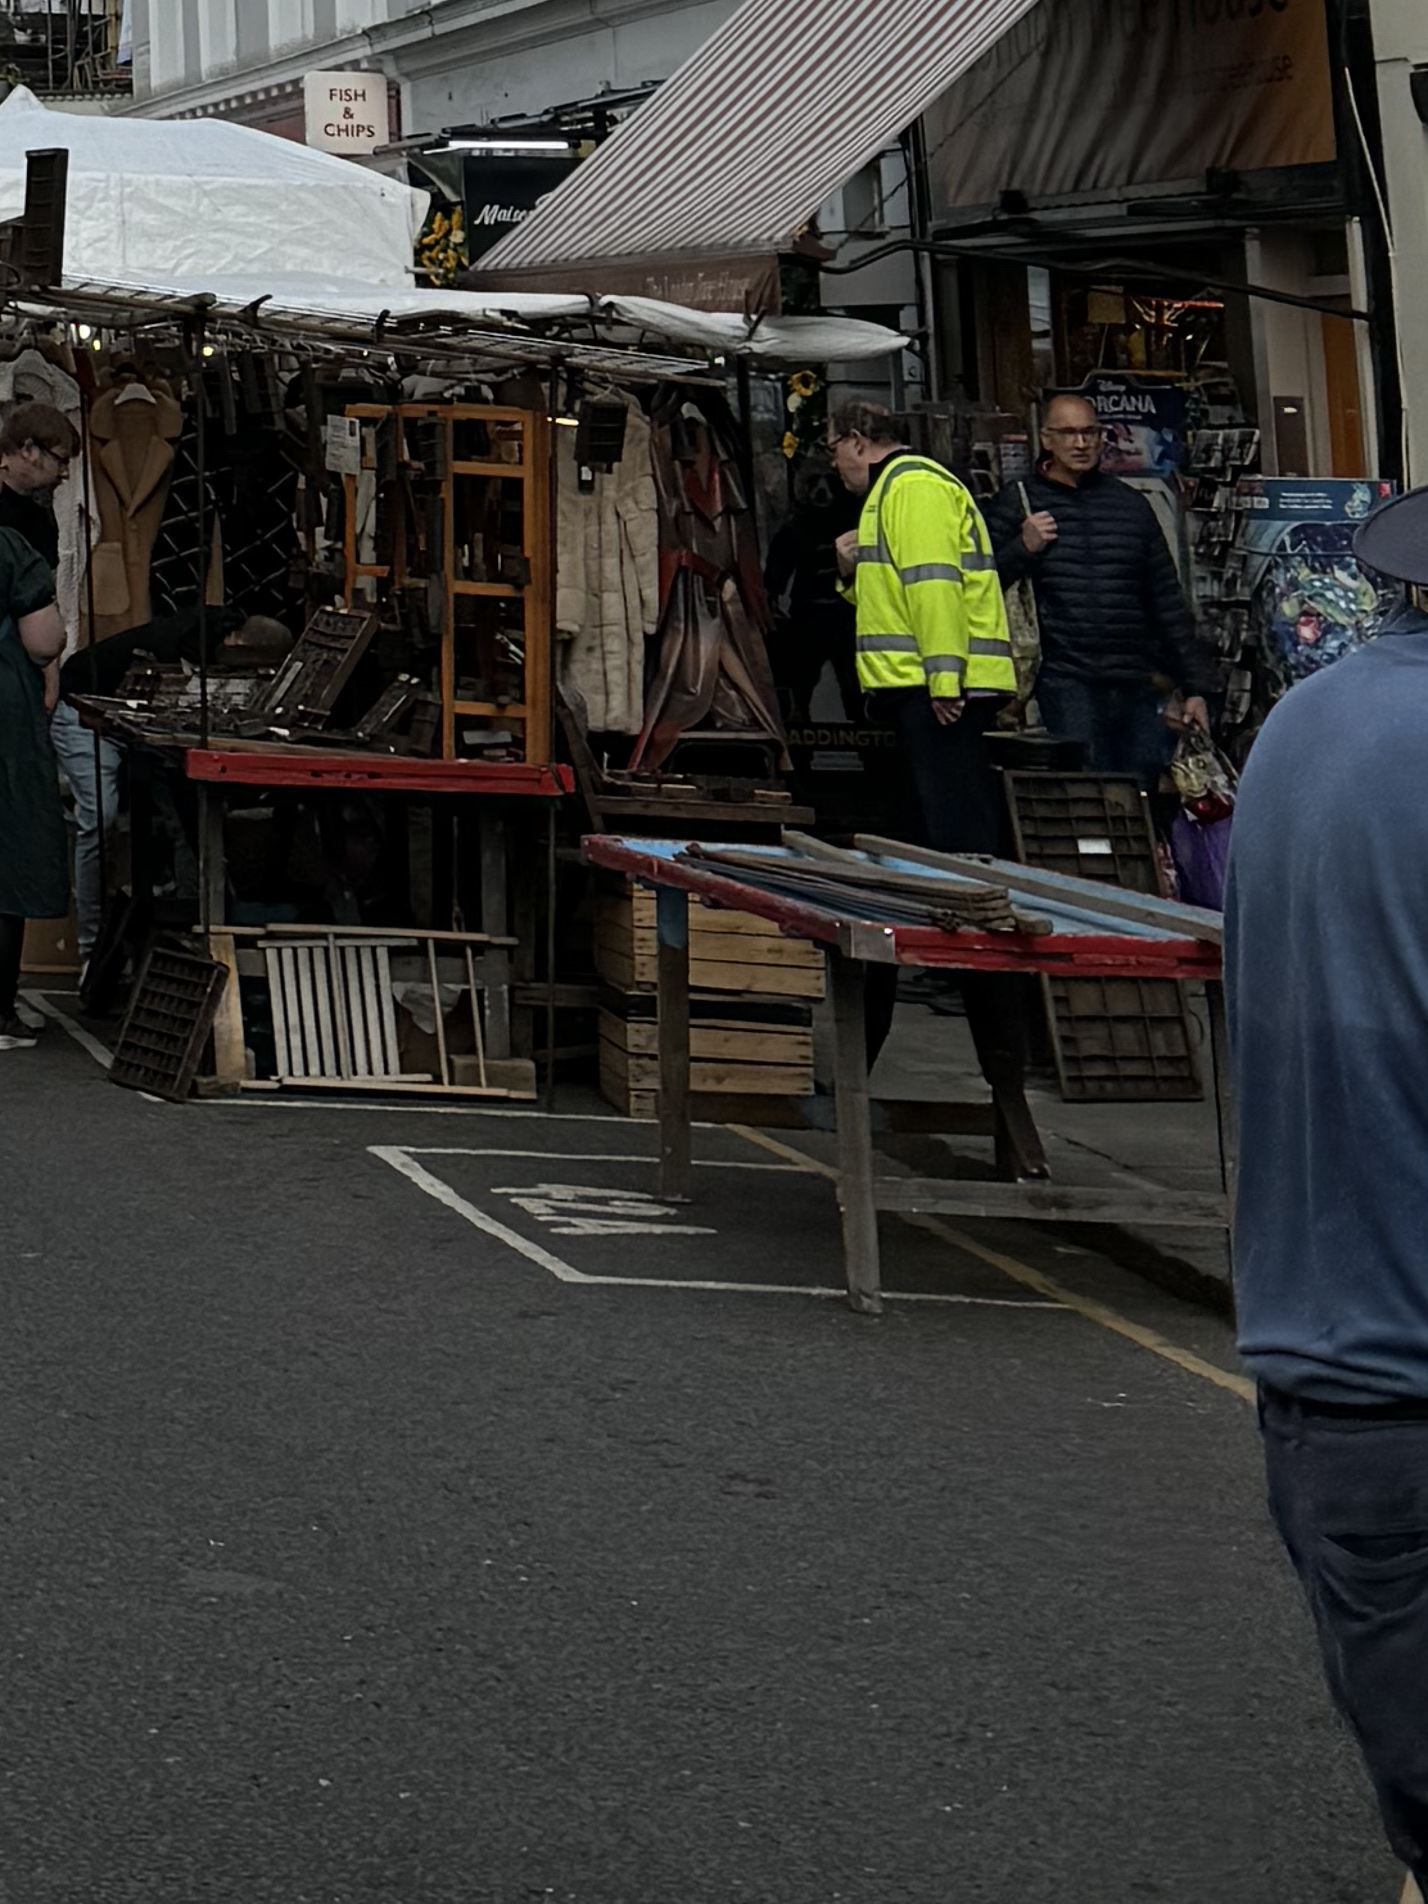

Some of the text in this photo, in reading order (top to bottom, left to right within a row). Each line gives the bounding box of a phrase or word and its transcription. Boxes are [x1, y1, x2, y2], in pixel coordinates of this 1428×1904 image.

[329, 88, 367, 102] FISH
[343, 107, 354, 120] &
[324, 123, 375, 138] CHIPS
[1085, 394, 1158, 414] ORCANA
[787, 728, 897, 748] ADDINGTO
